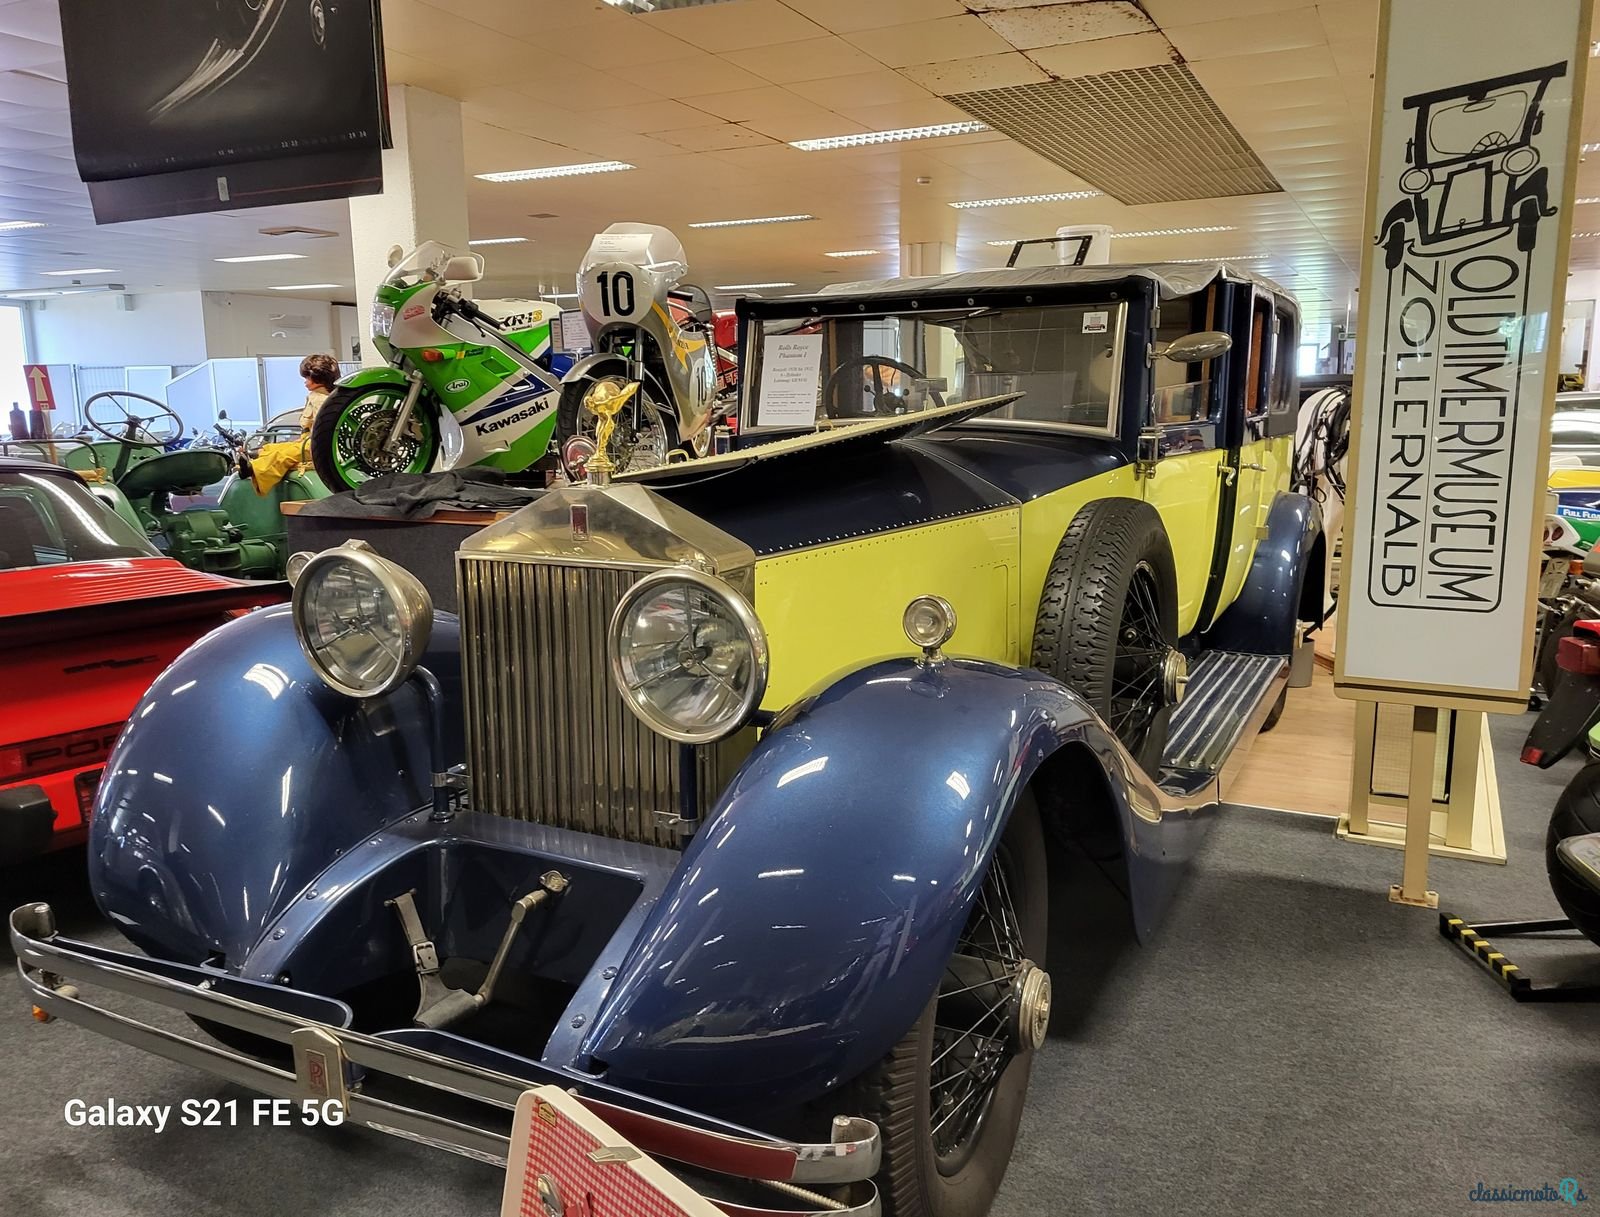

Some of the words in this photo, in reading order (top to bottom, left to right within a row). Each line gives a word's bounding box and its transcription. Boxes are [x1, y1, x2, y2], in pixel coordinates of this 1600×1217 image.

[596, 271, 635, 317] 10
[446, 380, 469, 391] Arai
[696, 365, 708, 408] 10
[475, 397, 549, 436] Kawasaki
[1382, 261, 1440, 597] ZOLLERNALB
[1426, 255, 1520, 603] OLDTIMERMUSEUM
